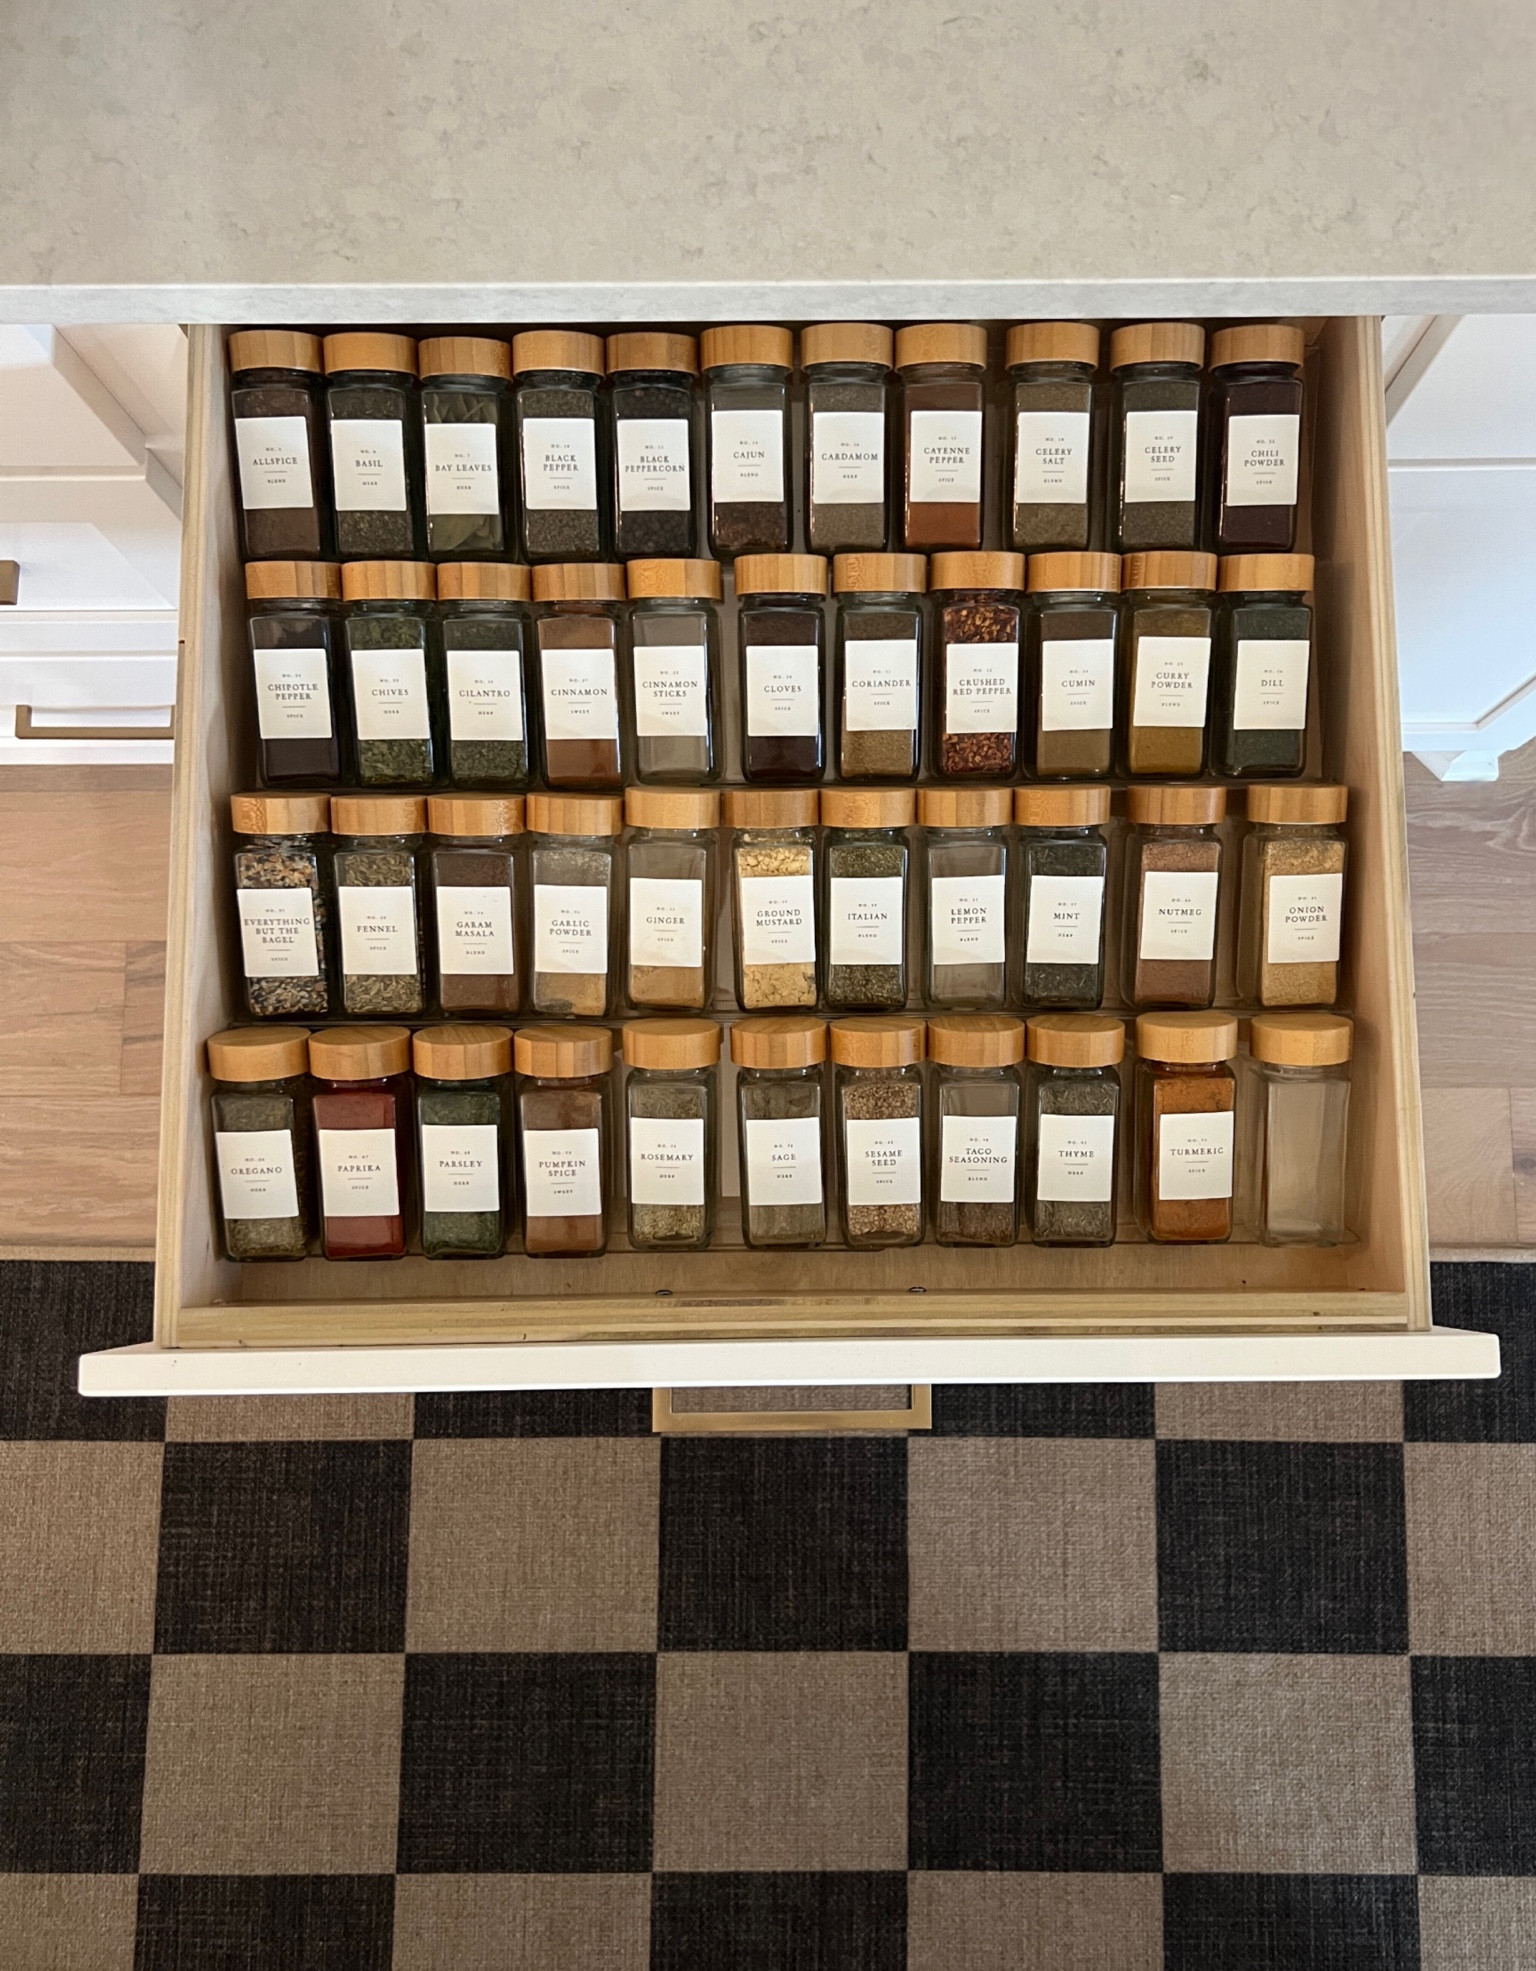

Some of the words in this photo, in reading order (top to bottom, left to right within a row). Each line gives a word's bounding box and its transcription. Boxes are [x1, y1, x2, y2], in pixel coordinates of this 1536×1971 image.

[923, 446, 971, 456] CAYENNE
[1034, 447, 1073, 456] CELERY
[1144, 445, 1182, 455] CELERY
[1250, 449, 1279, 459] CHILI
[544, 453, 577, 463] BLACK
[639, 455, 671, 465] BLACK
[732, 450, 766, 461] CAJUN
[820, 452, 879, 462] CARDAMOM
[928, 455, 965, 465] PEPPER
[1150, 454, 1176, 464] SEED
[252, 456, 299, 467] ALLSPICE
[354, 459, 384, 468] BASIL
[1041, 456, 1066, 466] SALT
[1243, 458, 1286, 468] POWDER
[434, 463, 453, 473] BAY
[455, 463, 493, 473] LEAVES
[542, 462, 580, 472] PEPPER
[624, 463, 686, 474] PEPPERCORN
[1155, 671, 1190, 680] CURRY
[640, 680, 699, 689] CINNAMON
[851, 678, 912, 688] CORIANDER
[955, 677, 1007, 687] CRUSHED
[1060, 679, 1096, 688] CUMIN
[1150, 680, 1194, 690] POWDER
[1260, 679, 1285, 688] DILL
[266, 683, 319, 692] CHIPOTLE
[371, 688, 410, 697] CHIVES
[550, 687, 608, 697] CINNAMON
[763, 684, 802, 694] CLOVES
[952, 687, 974, 697] RED
[976, 686, 1013, 697] PEPPER
[274, 692, 313, 701] PEPPER
[458, 689, 511, 698] CILANTRO
[652, 689, 688, 698] STICKS
[756, 908, 801, 919] GROUND
[950, 906, 988, 917] LEMON
[1157, 908, 1203, 917] NUTMEG
[1288, 905, 1325, 915] ONION
[645, 915, 686, 925] GINGER
[752, 916, 803, 927] MUSTARD
[847, 912, 888, 921] ITALIAN
[950, 915, 988, 925] PEPPER
[1052, 912, 1081, 921] MINT
[1284, 913, 1328, 924] POWDER
[243, 917, 311, 927] EVERYTHING
[455, 920, 493, 930] GARAM
[551, 919, 591, 929] GARLIC
[254, 926, 276, 936] BUT
[278, 926, 301, 936] THE
[356, 924, 399, 934] FENNEL
[454, 929, 495, 938] MASALA
[548, 927, 593, 937] POWDER
[261, 935, 296, 944] BAGEL
[864, 1149, 903, 1159] SESAME
[964, 1147, 993, 1156] TACO
[1057, 1149, 1095, 1159] THYME
[1169, 1146, 1224, 1157] TURMERIC
[640, 1152, 694, 1162] ROSEMARY
[771, 1153, 797, 1162] SAGE
[948, 1155, 1008, 1165] SEASONING
[438, 1159, 483, 1168] PARSLEY
[537, 1159, 586, 1169] PUMPKIN
[871, 1158, 897, 1167] SEED
[230, 1165, 283, 1176] OREGANO
[337, 1164, 382, 1173] PAPRIKA
[547, 1168, 577, 1178] SPICE
